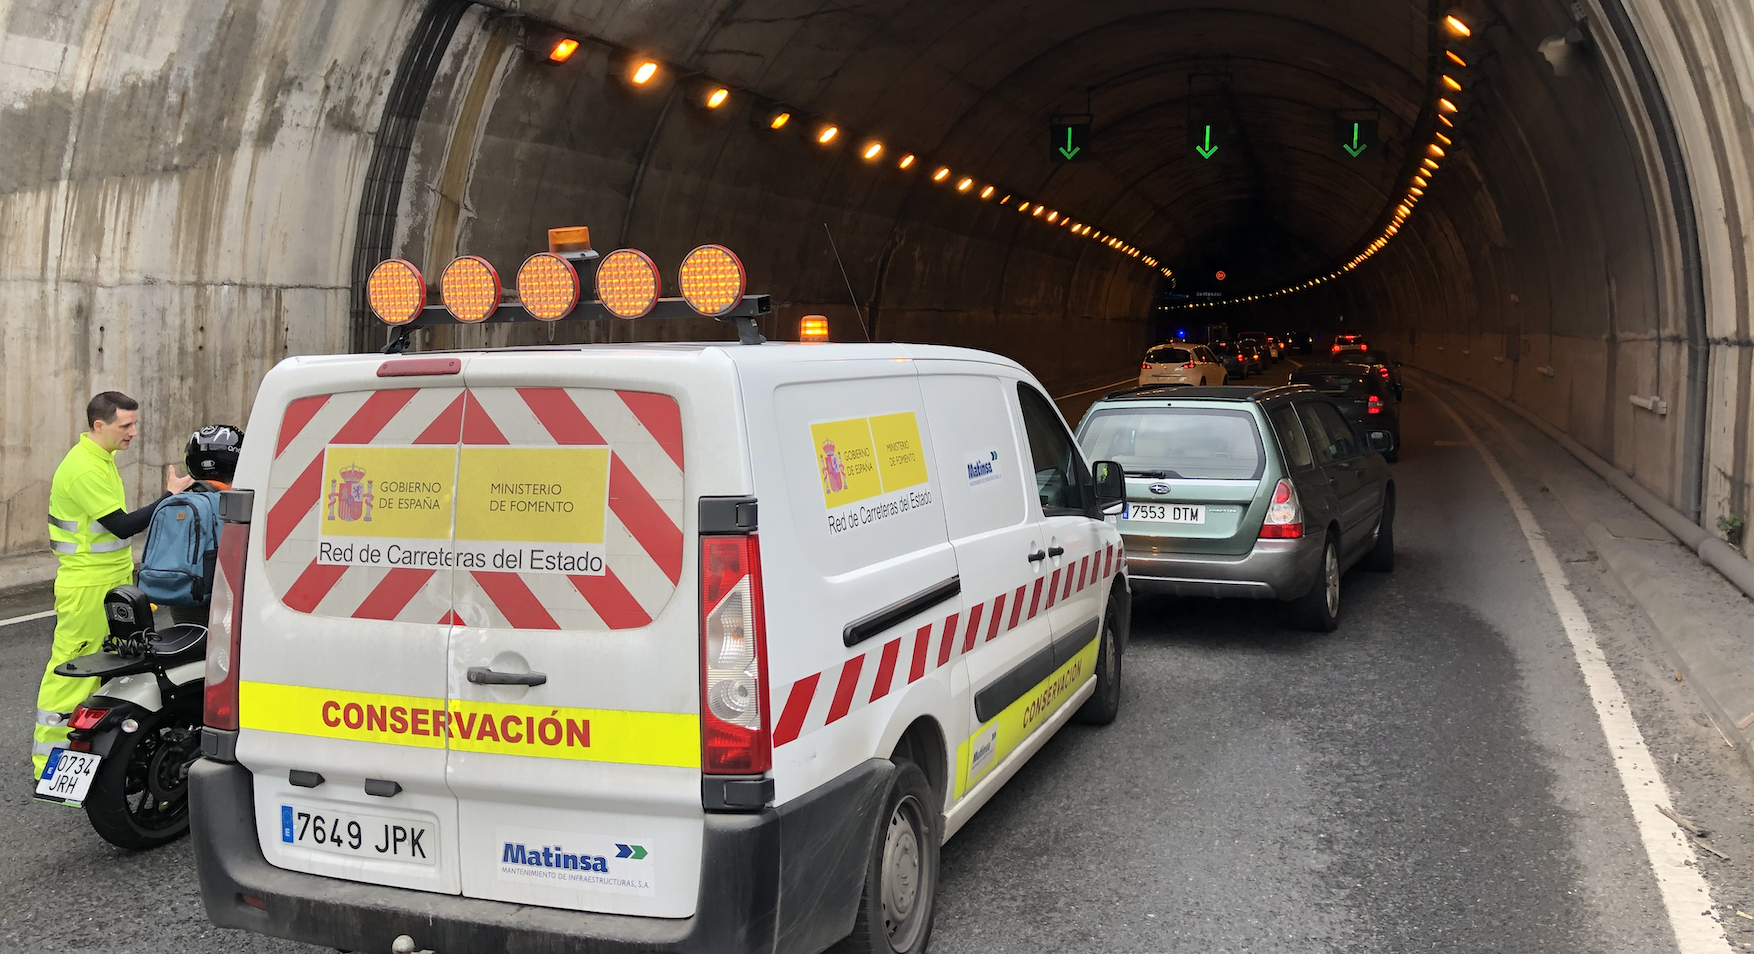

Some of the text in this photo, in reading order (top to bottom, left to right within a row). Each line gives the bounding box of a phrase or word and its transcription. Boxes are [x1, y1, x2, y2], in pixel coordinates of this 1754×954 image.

[844, 447, 870, 461] GOBIERNO
[886, 440, 910, 452] MINISTERIO
[847, 461, 873, 476] DE ESPAÑA
[889, 453, 916, 467] DE FOMENTO
[967, 460, 993, 480] Matinsa
[380, 481, 441, 494] GOBIERNO
[490, 483, 562, 496] MINISTERIO
[379, 496, 441, 510] DE ESPAÑA
[489, 500, 574, 513] DE FOMENTO
[828, 488, 932, 534] Red de Carreteras del Estado
[1132, 505, 1199, 521] 7553 DTM
[320, 542, 603, 572] Red de Carreteras del Estado
[321, 700, 591, 748] CONSERVACIÓN
[57, 755, 94, 776] 0734
[49, 774, 78, 794] JRH
[285, 812, 426, 859] E 7649 JPK
[502, 842, 609, 873] Matinsa
[501, 867, 650, 889] MANTENIMIENTO DE INFRAESTRUCTURAS, S.A.
